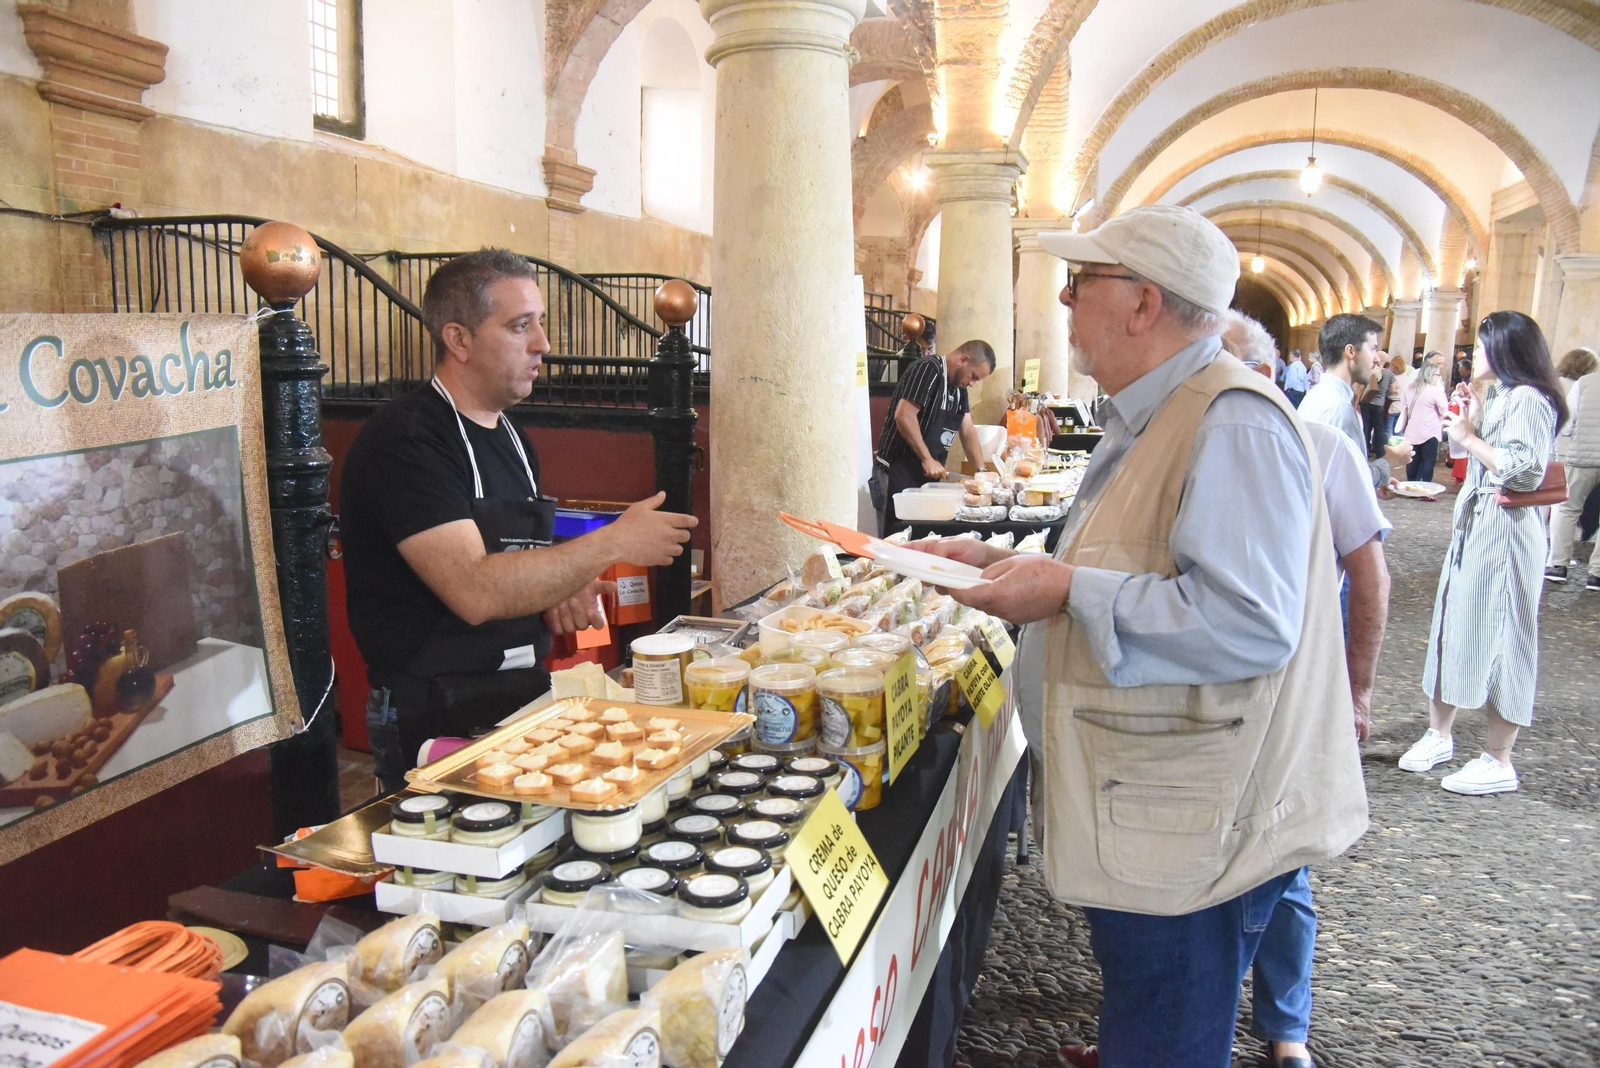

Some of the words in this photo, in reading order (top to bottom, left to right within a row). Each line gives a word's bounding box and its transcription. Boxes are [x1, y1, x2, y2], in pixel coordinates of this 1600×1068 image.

[19, 320, 237, 409] Covacha
[891, 672, 909, 703] CABRA
[963, 658, 977, 680] CABRA
[966, 673, 982, 698] PAYOYA
[980, 663, 990, 676] con
[972, 687, 986, 710] ACEITE
[983, 672, 996, 691] OLIVA
[892, 698, 913, 735] PAYOYA
[893, 723, 915, 764] PICANTE
[808, 834, 836, 875] CREMA
[831, 823, 844, 841] de
[822, 856, 849, 900] QUESO
[845, 845, 858, 863] de
[828, 895, 855, 939] CABRA
[849, 853, 877, 902] PAYOYA
